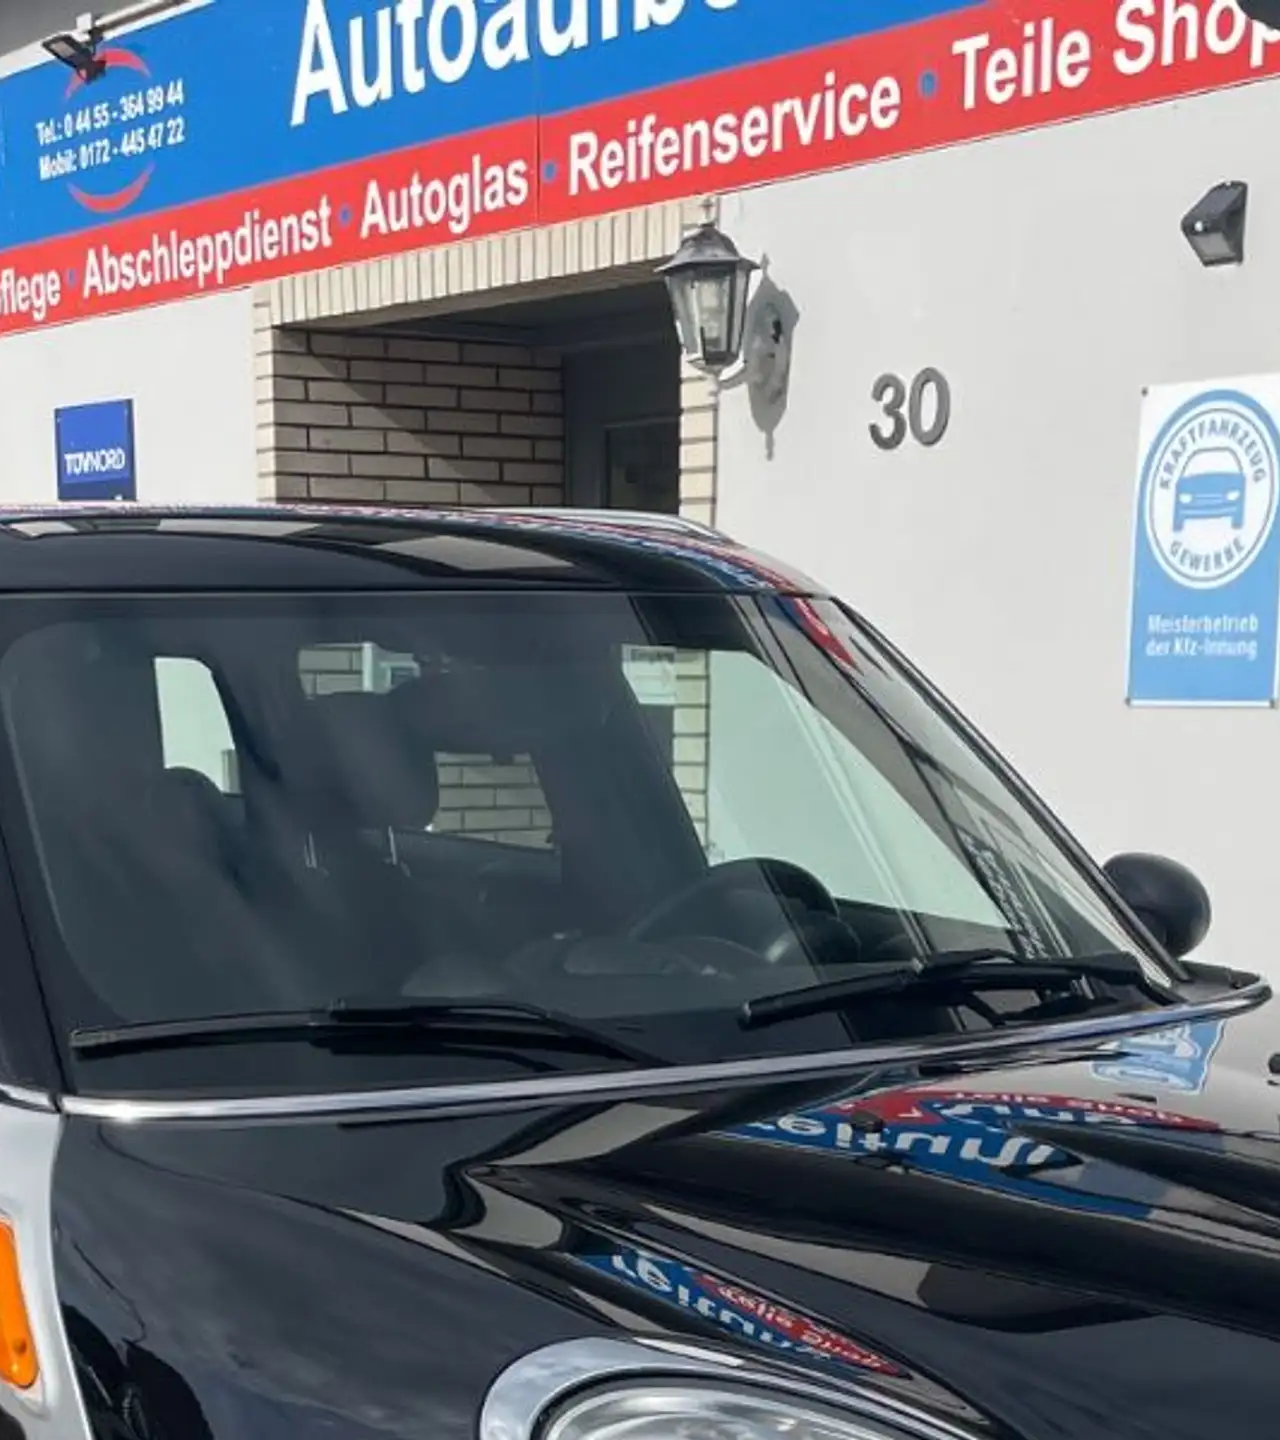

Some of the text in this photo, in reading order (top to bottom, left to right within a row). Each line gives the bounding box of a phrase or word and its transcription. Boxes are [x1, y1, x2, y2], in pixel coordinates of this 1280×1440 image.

[36, 118, 63, 146] Tel.:
[64, 113, 73, 138] 0
[75, 107, 91, 134] 44
[93, 101, 109, 128] 55
[120, 91, 144, 121] 364
[167, 78, 184, 107] 44
[39, 149, 77, 181] Mobil:
[80, 138, 110, 170] 0172
[120, 127, 145, 157] 445
[148, 122, 164, 150] 47
[167, 115, 185, 145] 22
[83, 194, 332, 298] Abschleppdienst
[360, 153, 529, 239] Autoglas
[569, 70, 902, 195] Reifenservice
[951, 18, 1091, 110] Teile
[868, 367, 951, 450] 30
[1145, 637, 1171, 657] der
[1147, 613, 1259, 634] Meisterbetrieb
